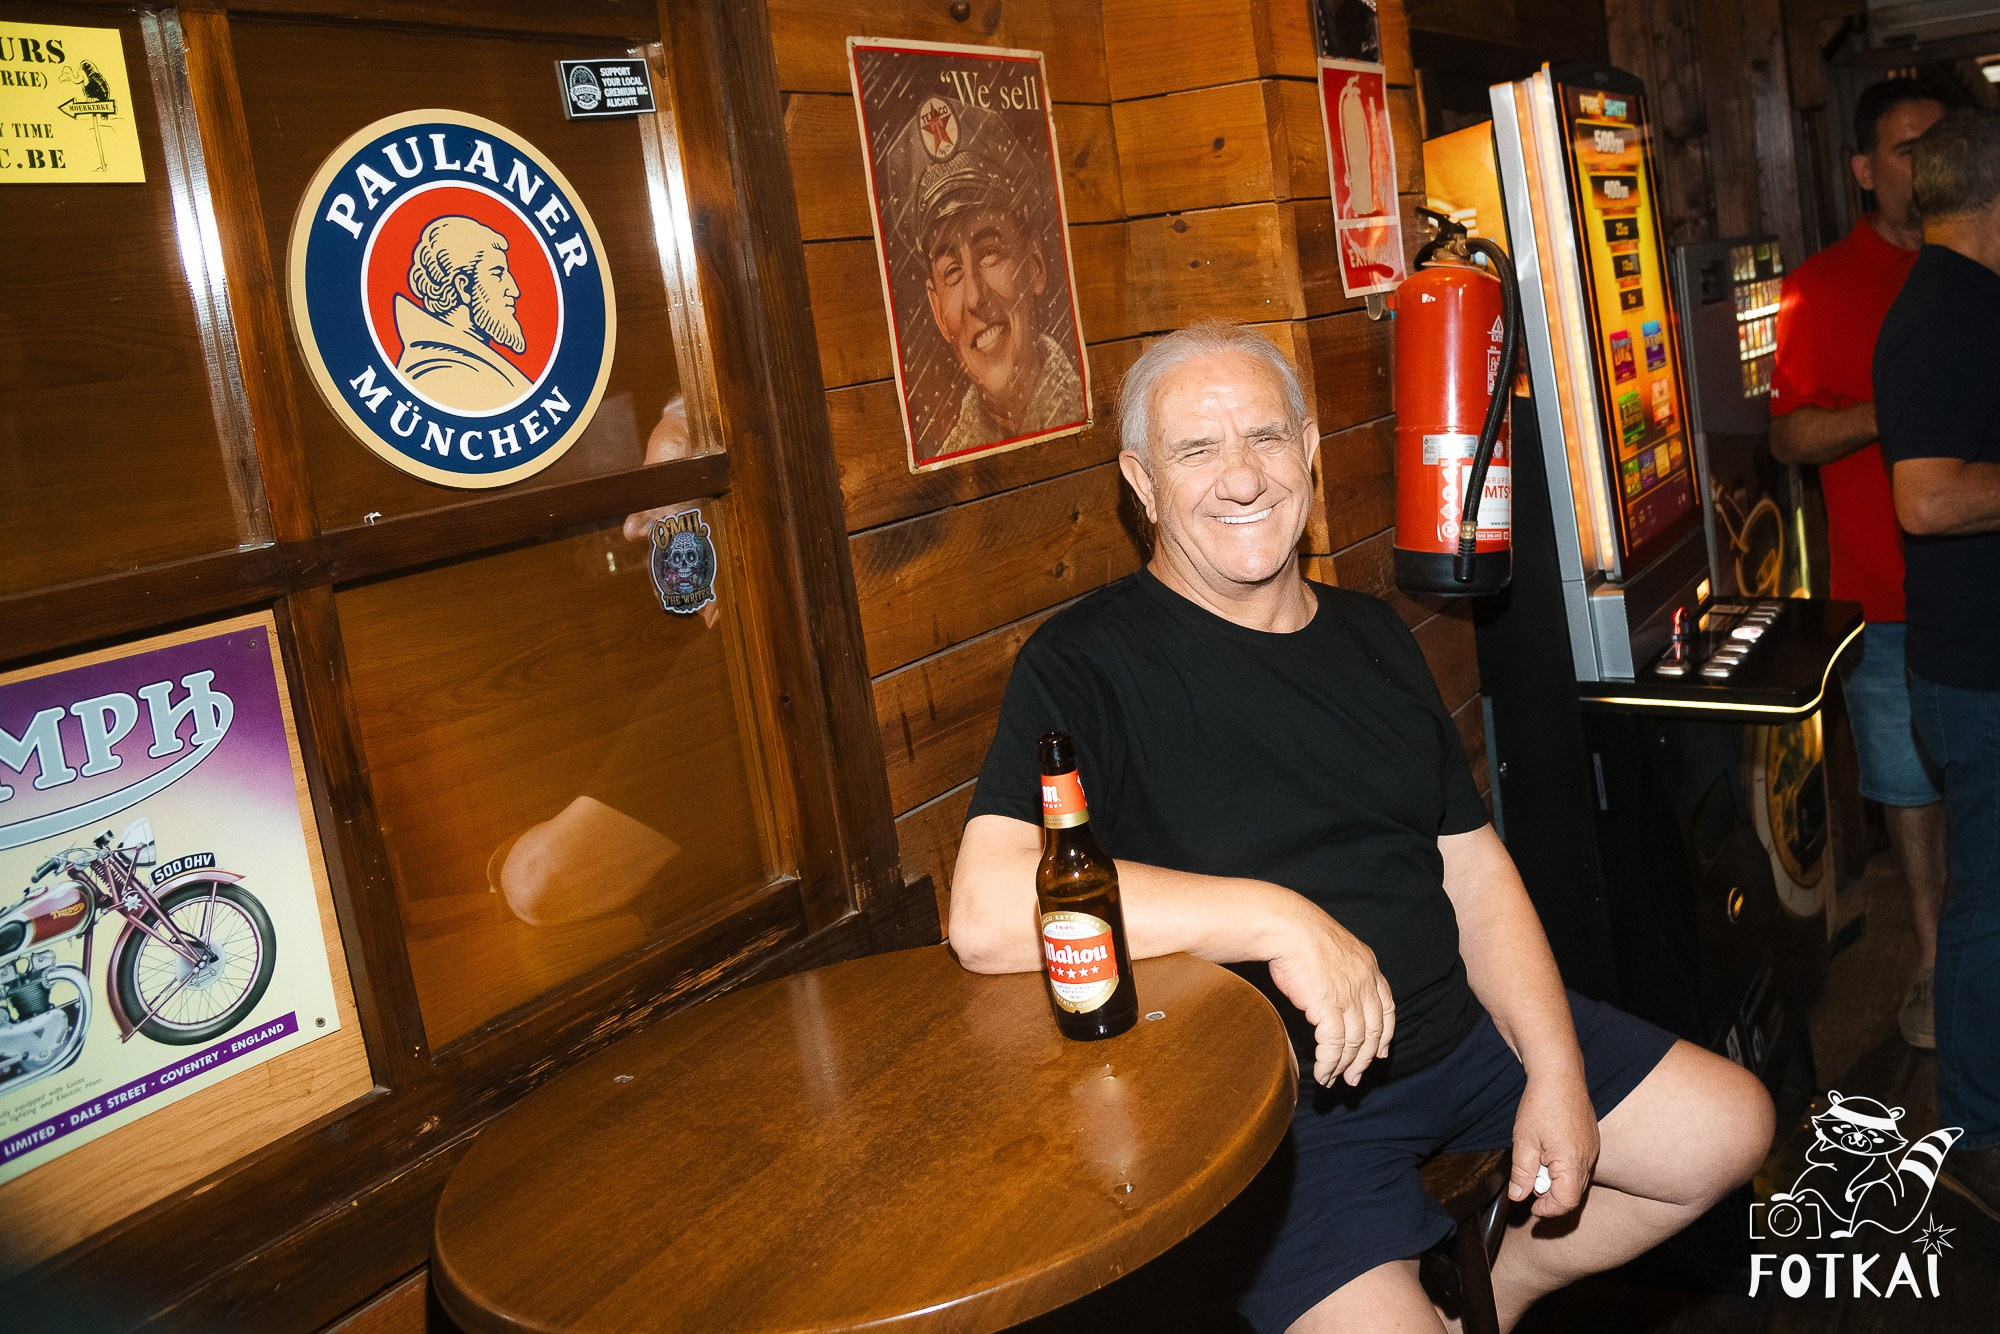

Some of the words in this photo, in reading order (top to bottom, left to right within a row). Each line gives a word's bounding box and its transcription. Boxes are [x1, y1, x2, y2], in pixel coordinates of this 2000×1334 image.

[0, 37, 66, 64] URS
[0, 71, 48, 89] RKE)
[600, 68, 630, 77] SUPPORT
[602, 78, 621, 87] YOUR
[622, 77, 643, 86] LOCAL
[604, 88, 636, 97] GREMIUM
[607, 98, 638, 107] ALICANTE
[999, 75, 1040, 111] sell
[12, 123, 54, 138] TIME
[0, 149, 67, 169] C.BE
[325, 133, 590, 277] PAULANER
[349, 364, 572, 461] MÜNCHEN
[664, 594, 681, 606] THE
[682, 587, 712, 604] WRITER
[0, 669, 235, 801] MPH
[154, 861, 182, 883] 500
[1044, 939, 1109, 965] Mahou
[4, 1125, 56, 1157] LIMITED
[70, 1103, 103, 1127] DALE
[107, 1083, 148, 1110] STREET
[160, 1051, 220, 1086] COVENTRY
[230, 1022, 285, 1054] ENGLAND
